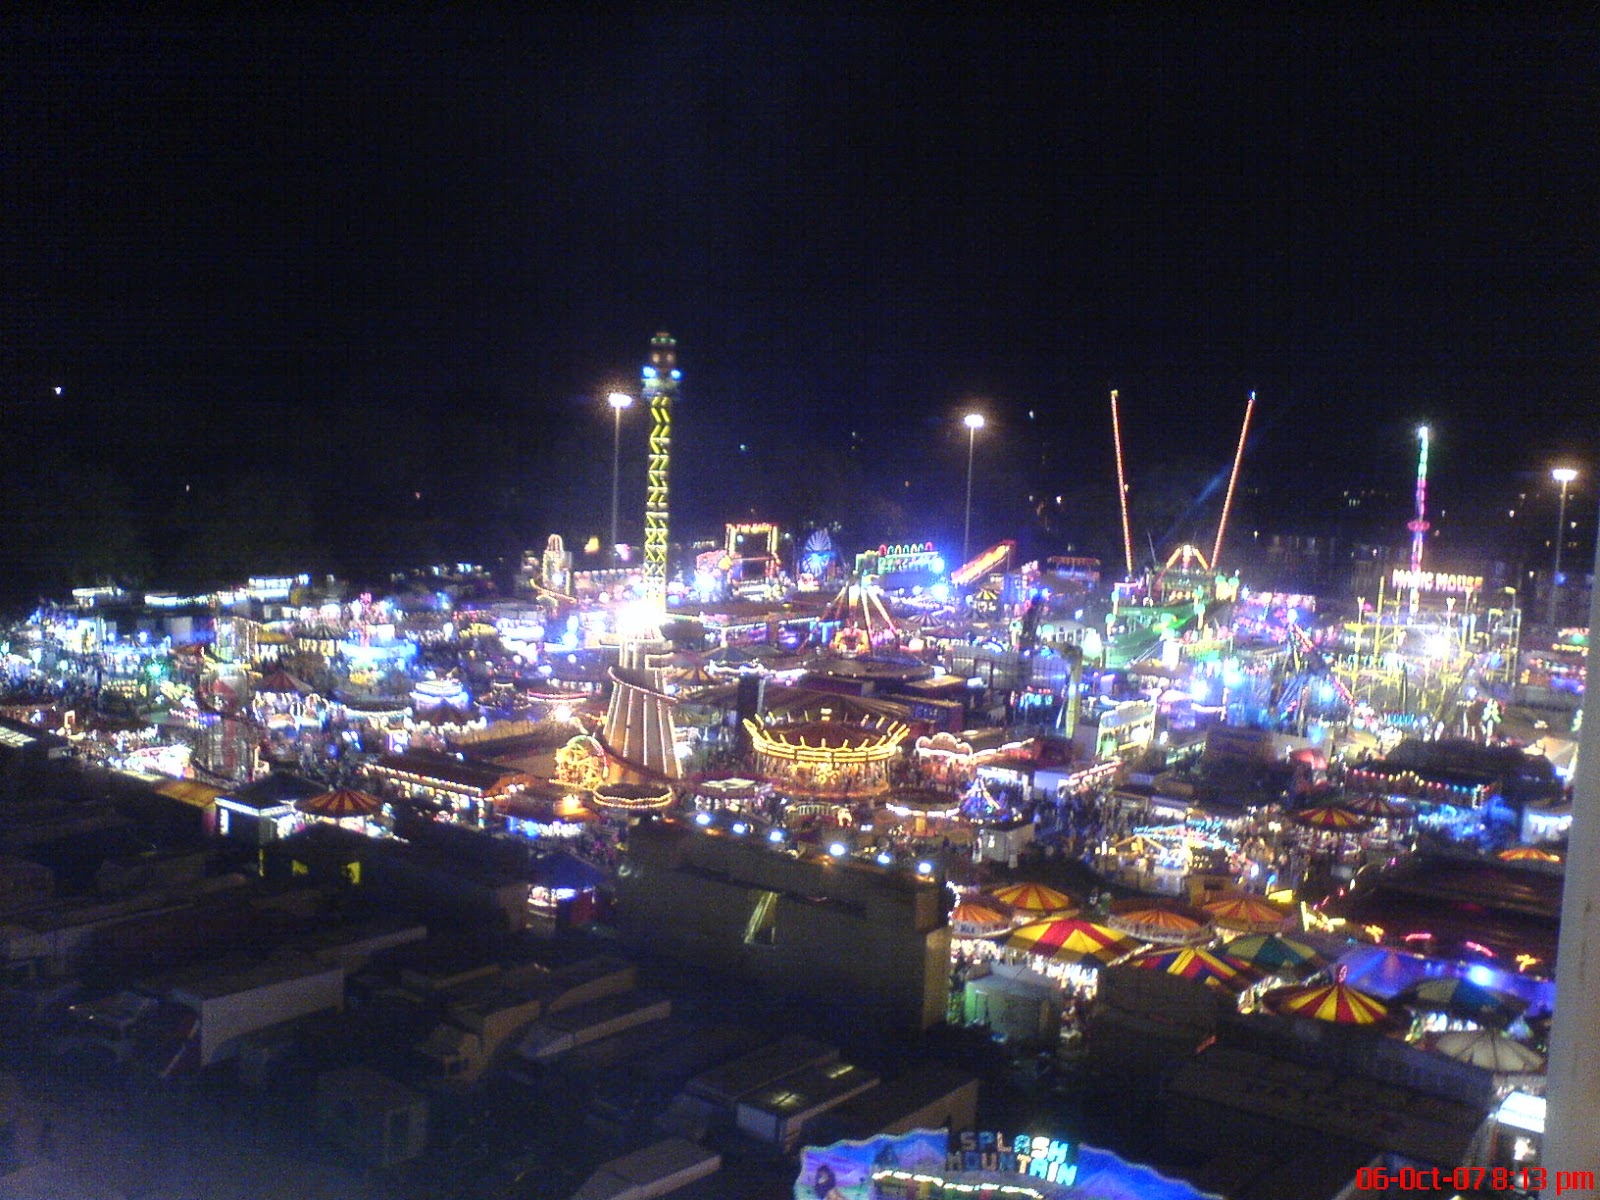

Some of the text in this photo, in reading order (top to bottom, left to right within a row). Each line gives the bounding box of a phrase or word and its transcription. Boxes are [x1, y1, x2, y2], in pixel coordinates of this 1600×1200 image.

[1436, 572, 1483, 592] MOUSE
[960, 1131, 1069, 1164] SPLASH
[946, 1151, 1077, 1186] MOUNTAIN
